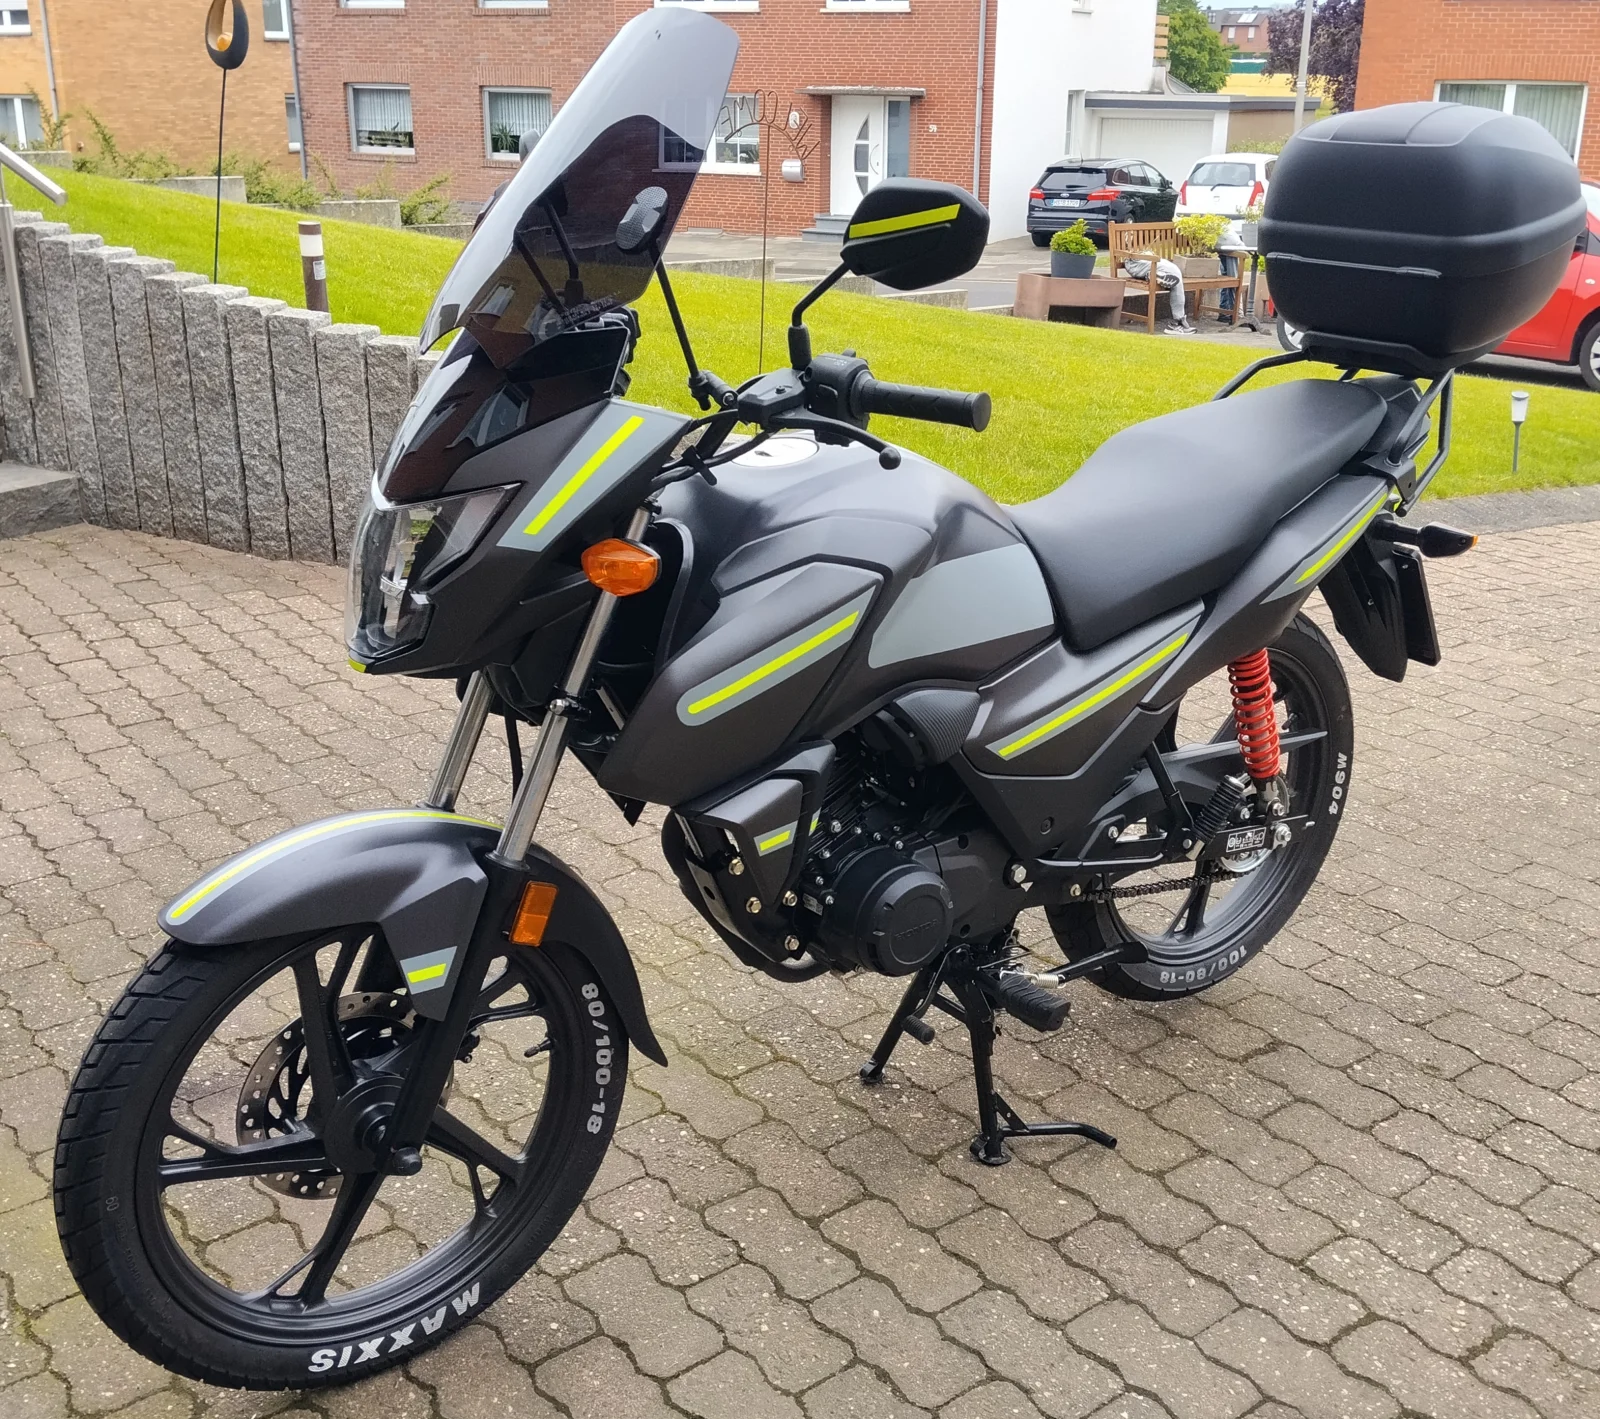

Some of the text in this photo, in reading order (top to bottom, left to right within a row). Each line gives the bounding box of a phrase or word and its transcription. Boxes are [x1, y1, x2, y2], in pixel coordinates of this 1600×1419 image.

[1328, 752, 1348, 815] M904
[1160, 945, 1247, 984] 100/80-18
[581, 982, 612, 1134] 80/100-18
[307, 1282, 480, 1373] MAXXIS
